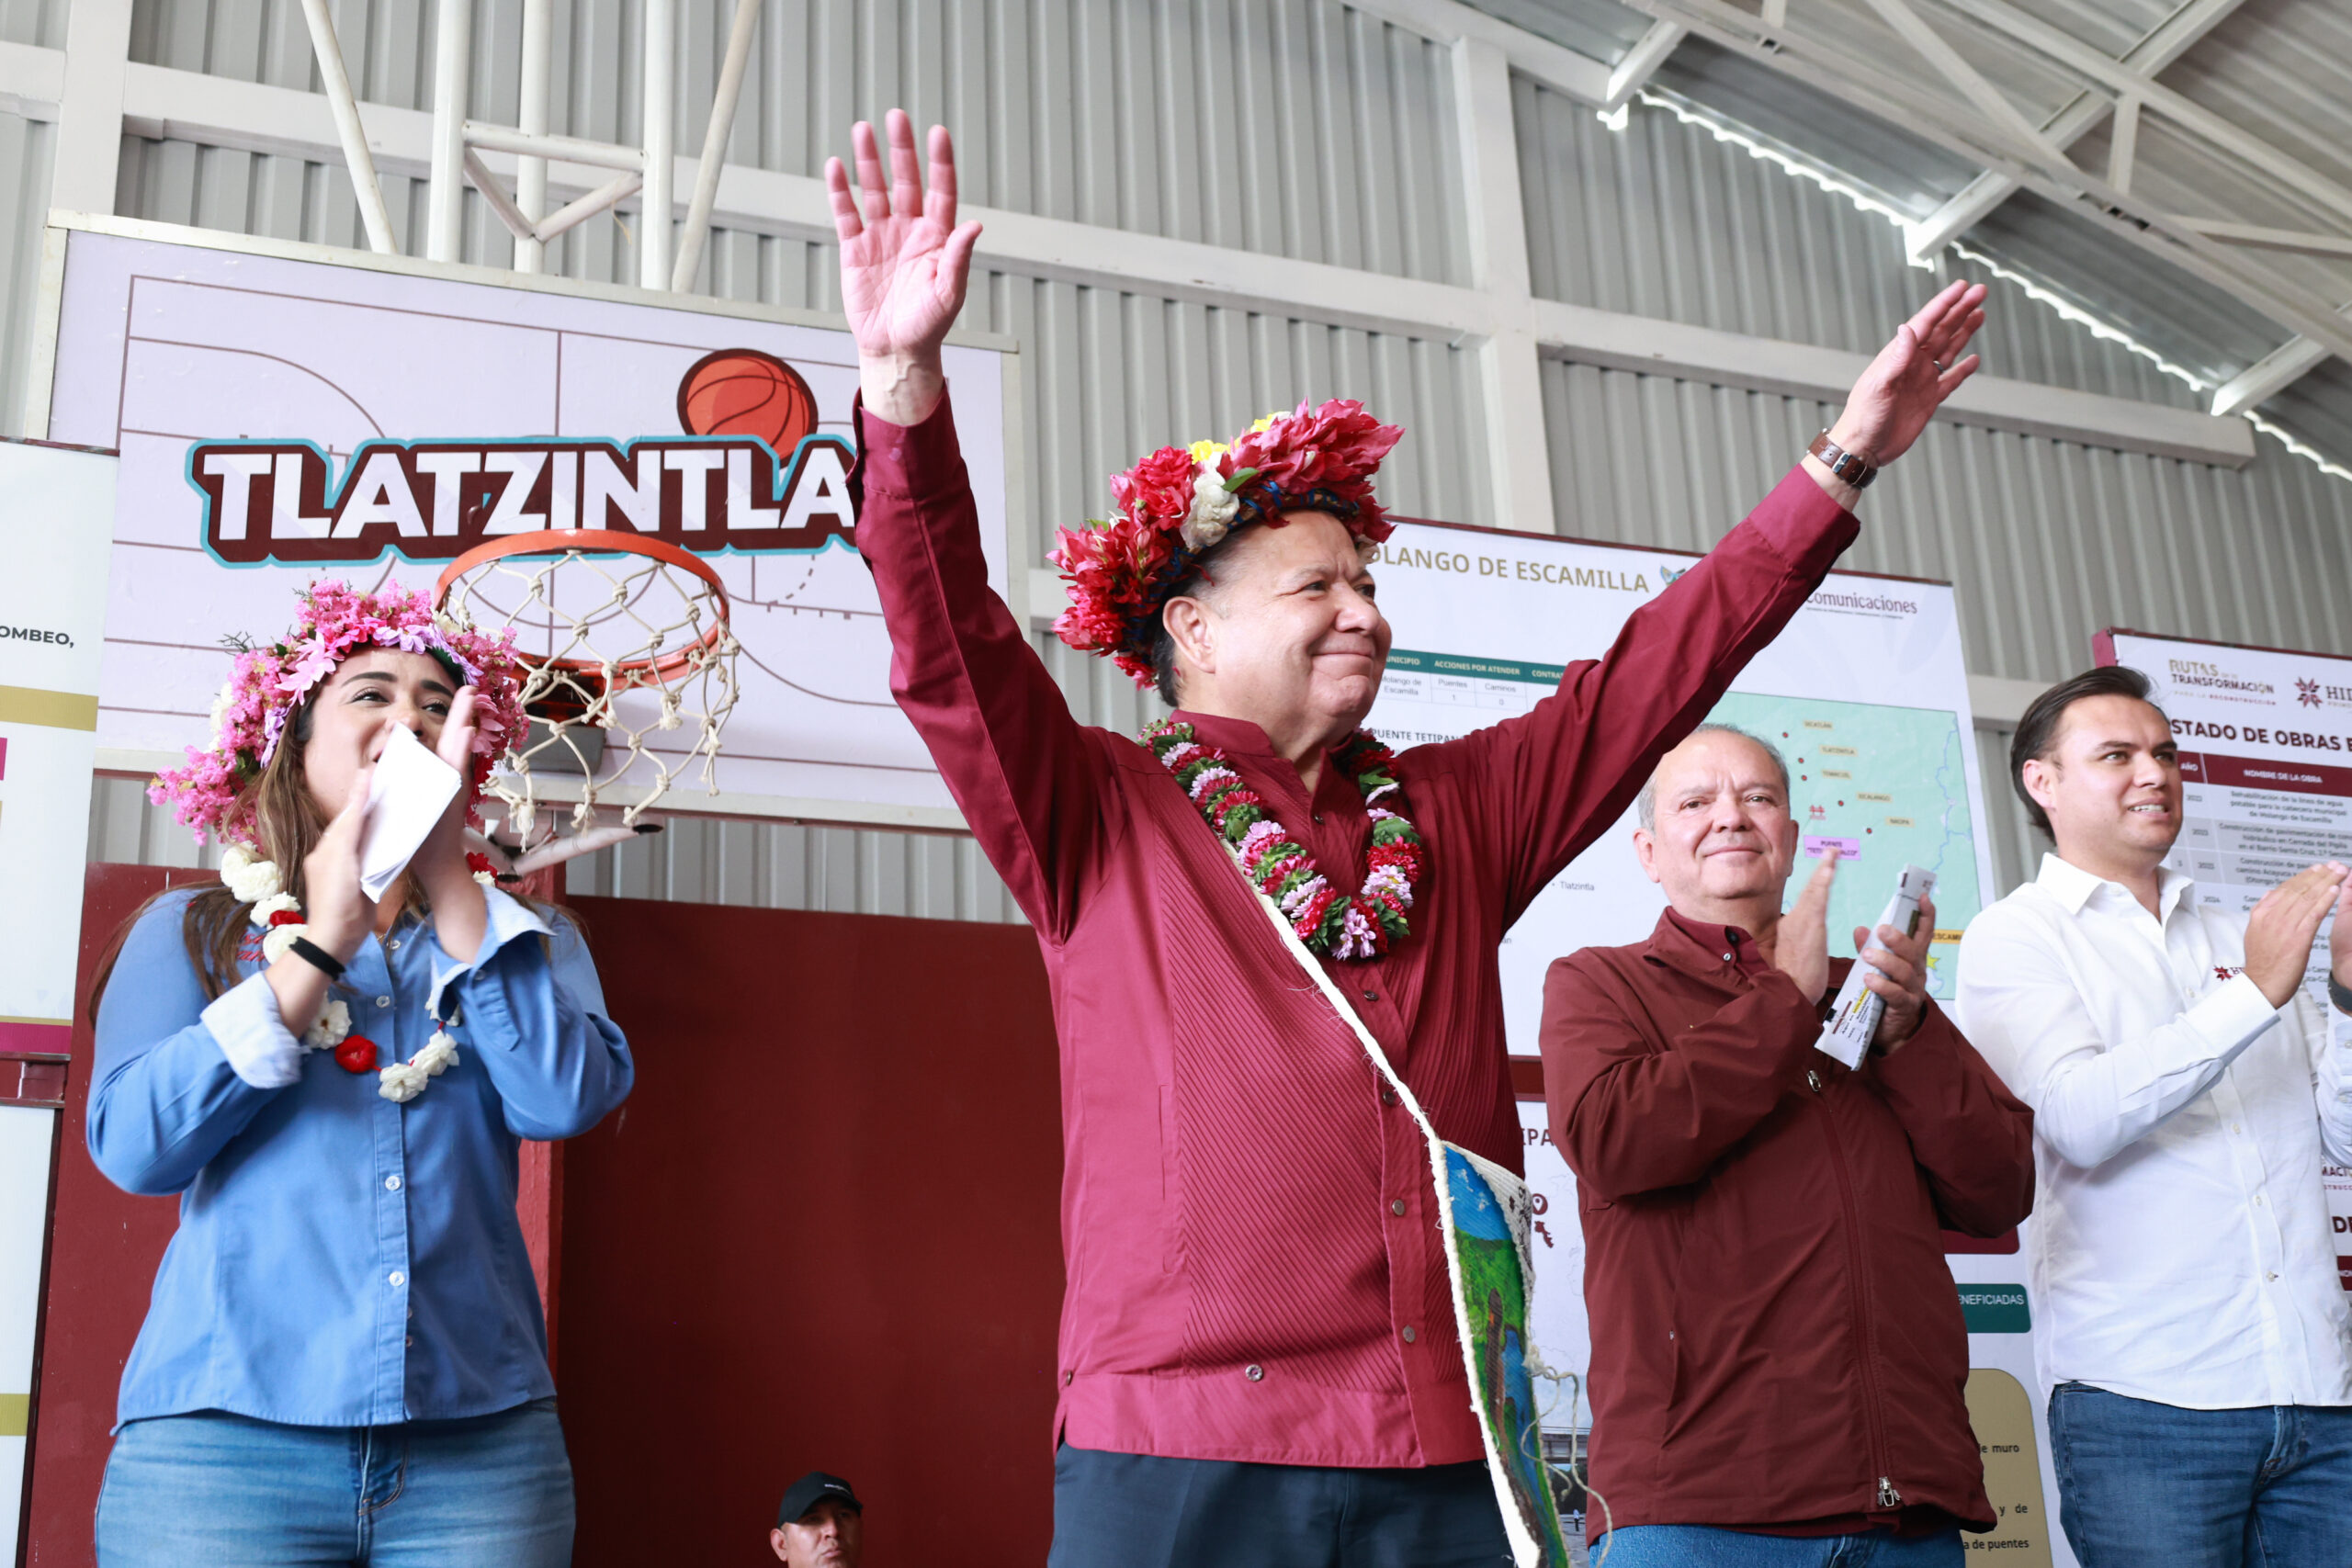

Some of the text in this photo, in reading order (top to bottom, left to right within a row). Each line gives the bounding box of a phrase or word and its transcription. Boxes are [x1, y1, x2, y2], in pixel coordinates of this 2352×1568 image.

[201, 446, 856, 542] TLATZINTLA
[1478, 556, 1508, 578] DE
[1516, 561, 1650, 592] ESCAMILLA
[0, 626, 75, 649] OMBEO,
[1434, 660, 1470, 671] ACCIONES
[1472, 663, 1487, 671] POR
[1488, 666, 1521, 675] ATENDER
[1438, 678, 1467, 688] Puentes
[1485, 682, 1516, 693] Caminos
[2243, 727, 2269, 744] DE
[2275, 730, 2341, 751] OBRAS
[1560, 881, 1595, 891] Tlatzintla
[1992, 1444, 2019, 1453] muro
[1999, 1504, 2028, 1517] y de
[1973, 1540, 1984, 1550] de
[1987, 1539, 2030, 1551] puentes
